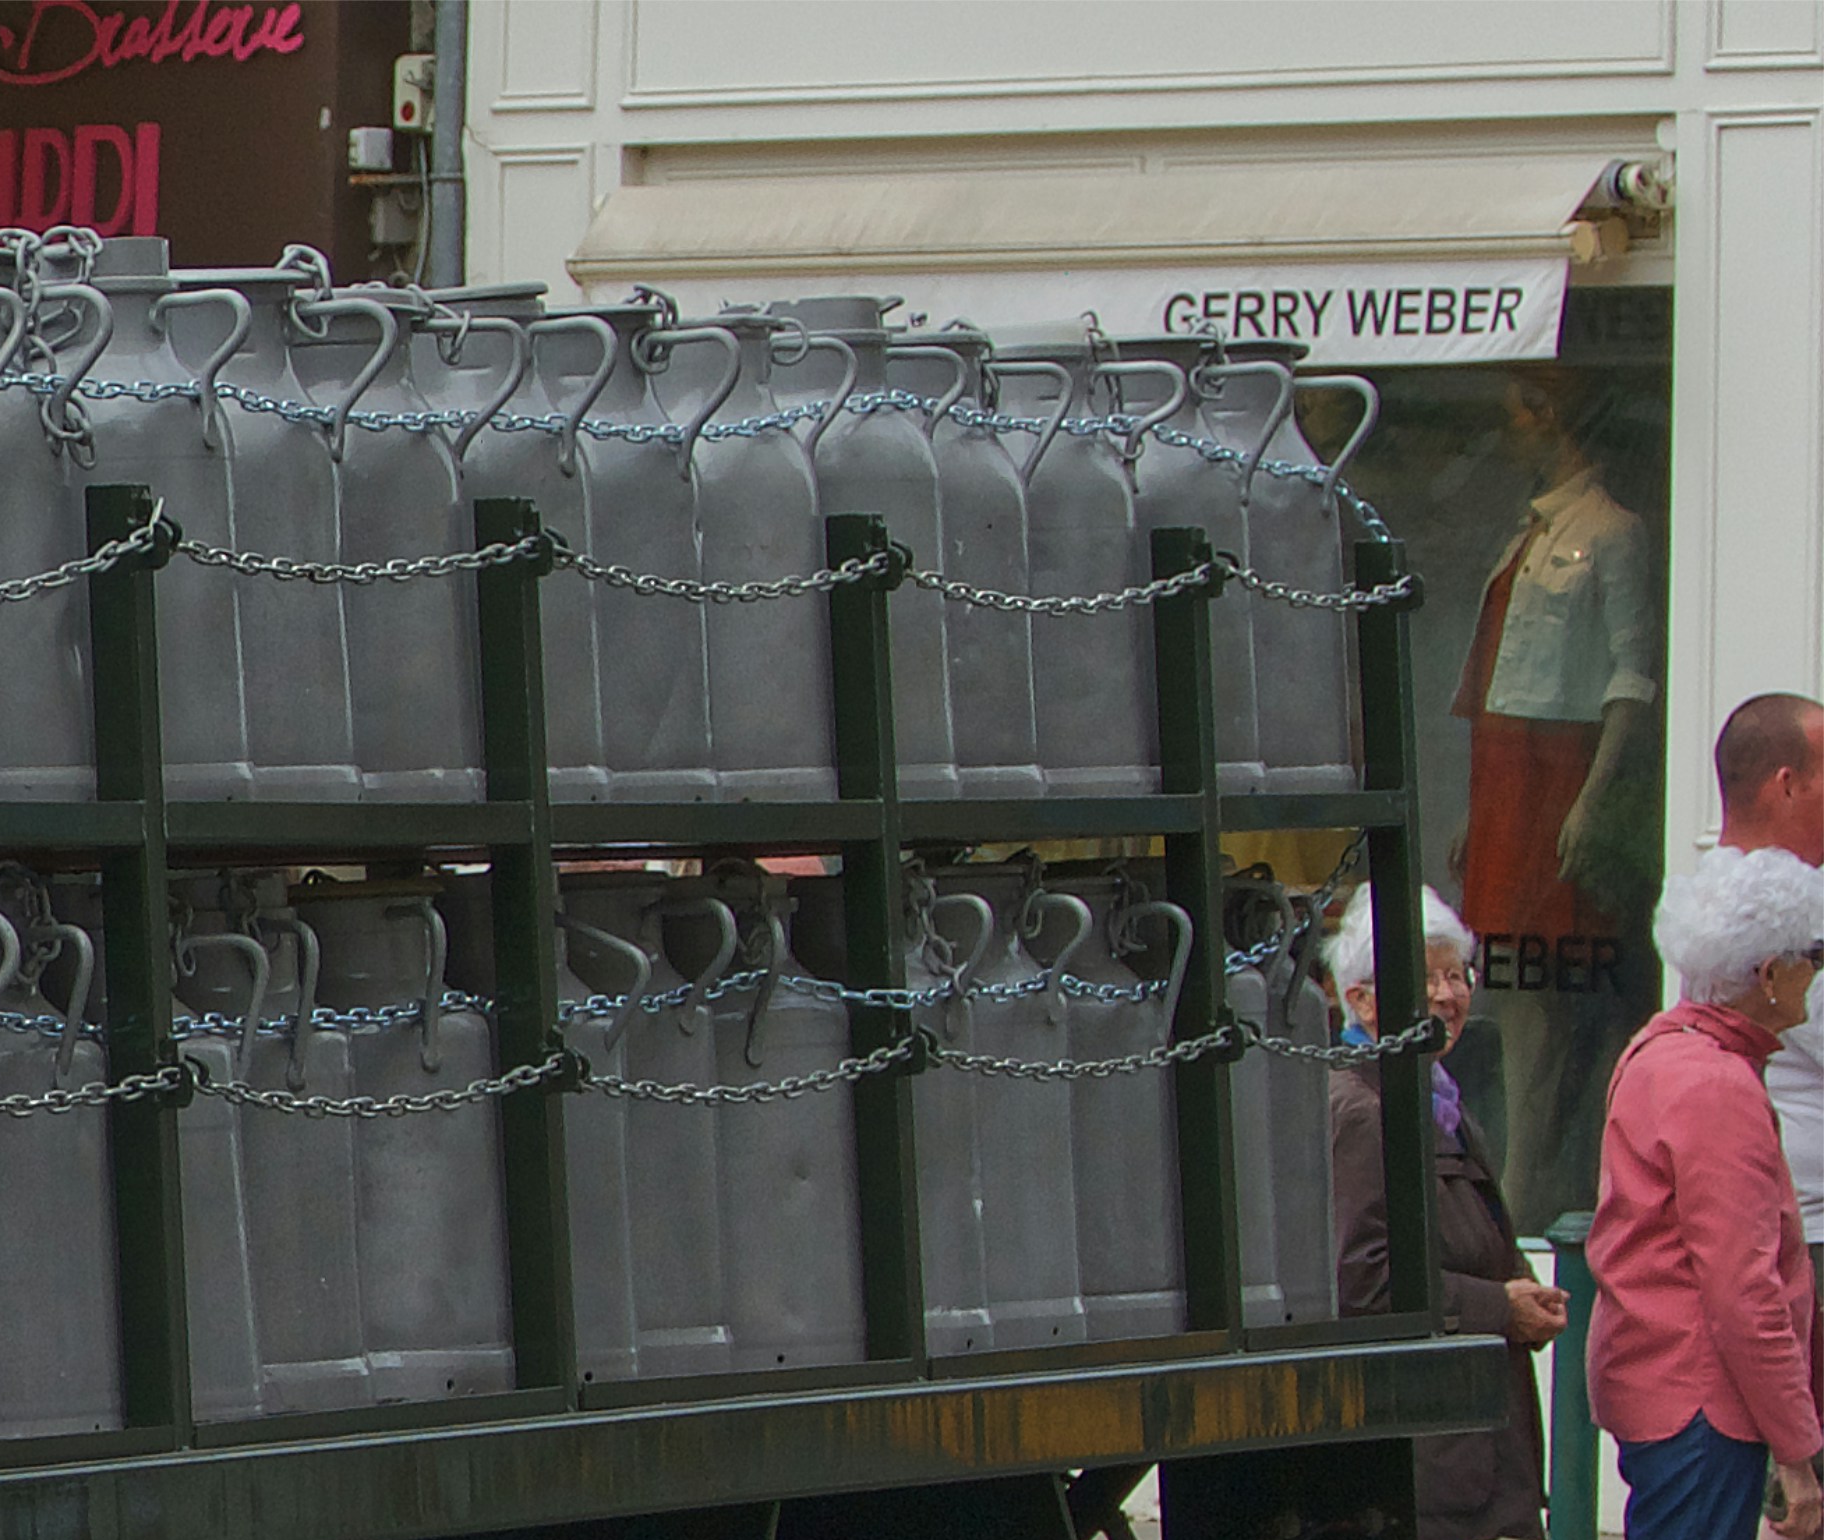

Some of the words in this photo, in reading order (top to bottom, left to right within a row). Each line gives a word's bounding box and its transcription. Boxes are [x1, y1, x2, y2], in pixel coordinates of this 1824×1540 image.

[1163, 288, 1334, 338] GERRY
[1346, 287, 1524, 337] WEBER
[1484, 933, 1623, 992] EBER
